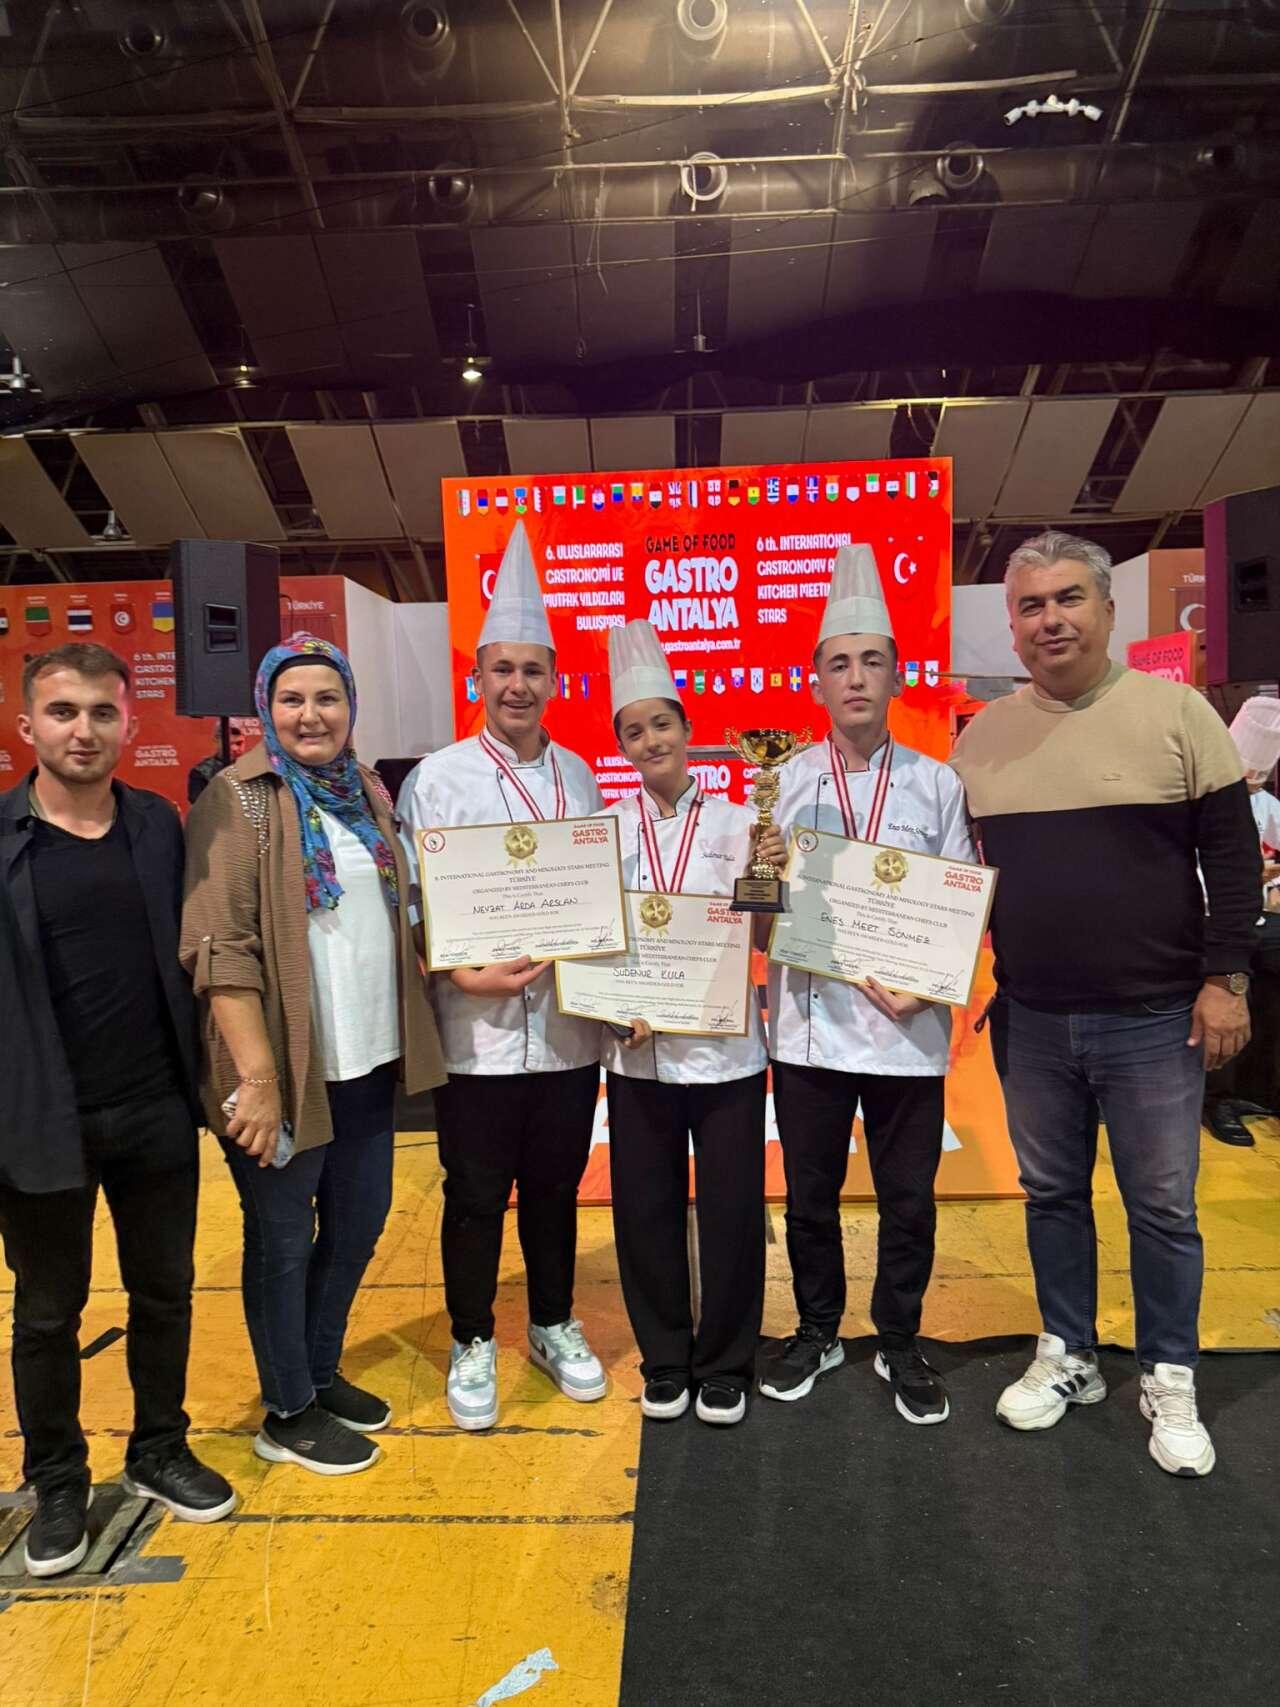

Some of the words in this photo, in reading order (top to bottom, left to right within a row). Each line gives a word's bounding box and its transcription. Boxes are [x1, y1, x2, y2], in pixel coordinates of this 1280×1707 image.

[646, 536, 679, 553] GAME
[683, 535, 699, 552] OF
[702, 533, 736, 551] FOOD
[757, 536, 764, 552] 6
[780, 533, 851, 551] INTERNATIONAL
[545, 545, 556, 560] 6.
[556, 542, 624, 560] ULUSLARARASI
[612, 566, 624, 582] VE
[645, 556, 739, 594] GASTRO
[757, 558, 826, 576] GASTRONOMY
[543, 592, 579, 608] MUTFAK
[579, 590, 625, 607] YILDIZLARI
[757, 584, 798, 600] KITCHEN
[648, 597, 739, 631] ANTALYA
[757, 608, 787, 624] STARS
[135, 748, 177, 758] GASTRO
[134, 758, 180, 767] ANTALYA
[572, 828, 608, 837] GASTRO
[573, 836, 608, 845] ANTALYA
[944, 871, 983, 884] GASTRO
[944, 880, 982, 893] ANTALYA
[706, 916, 743, 924] ANTALYA
[661, 969, 685, 980] KULA
